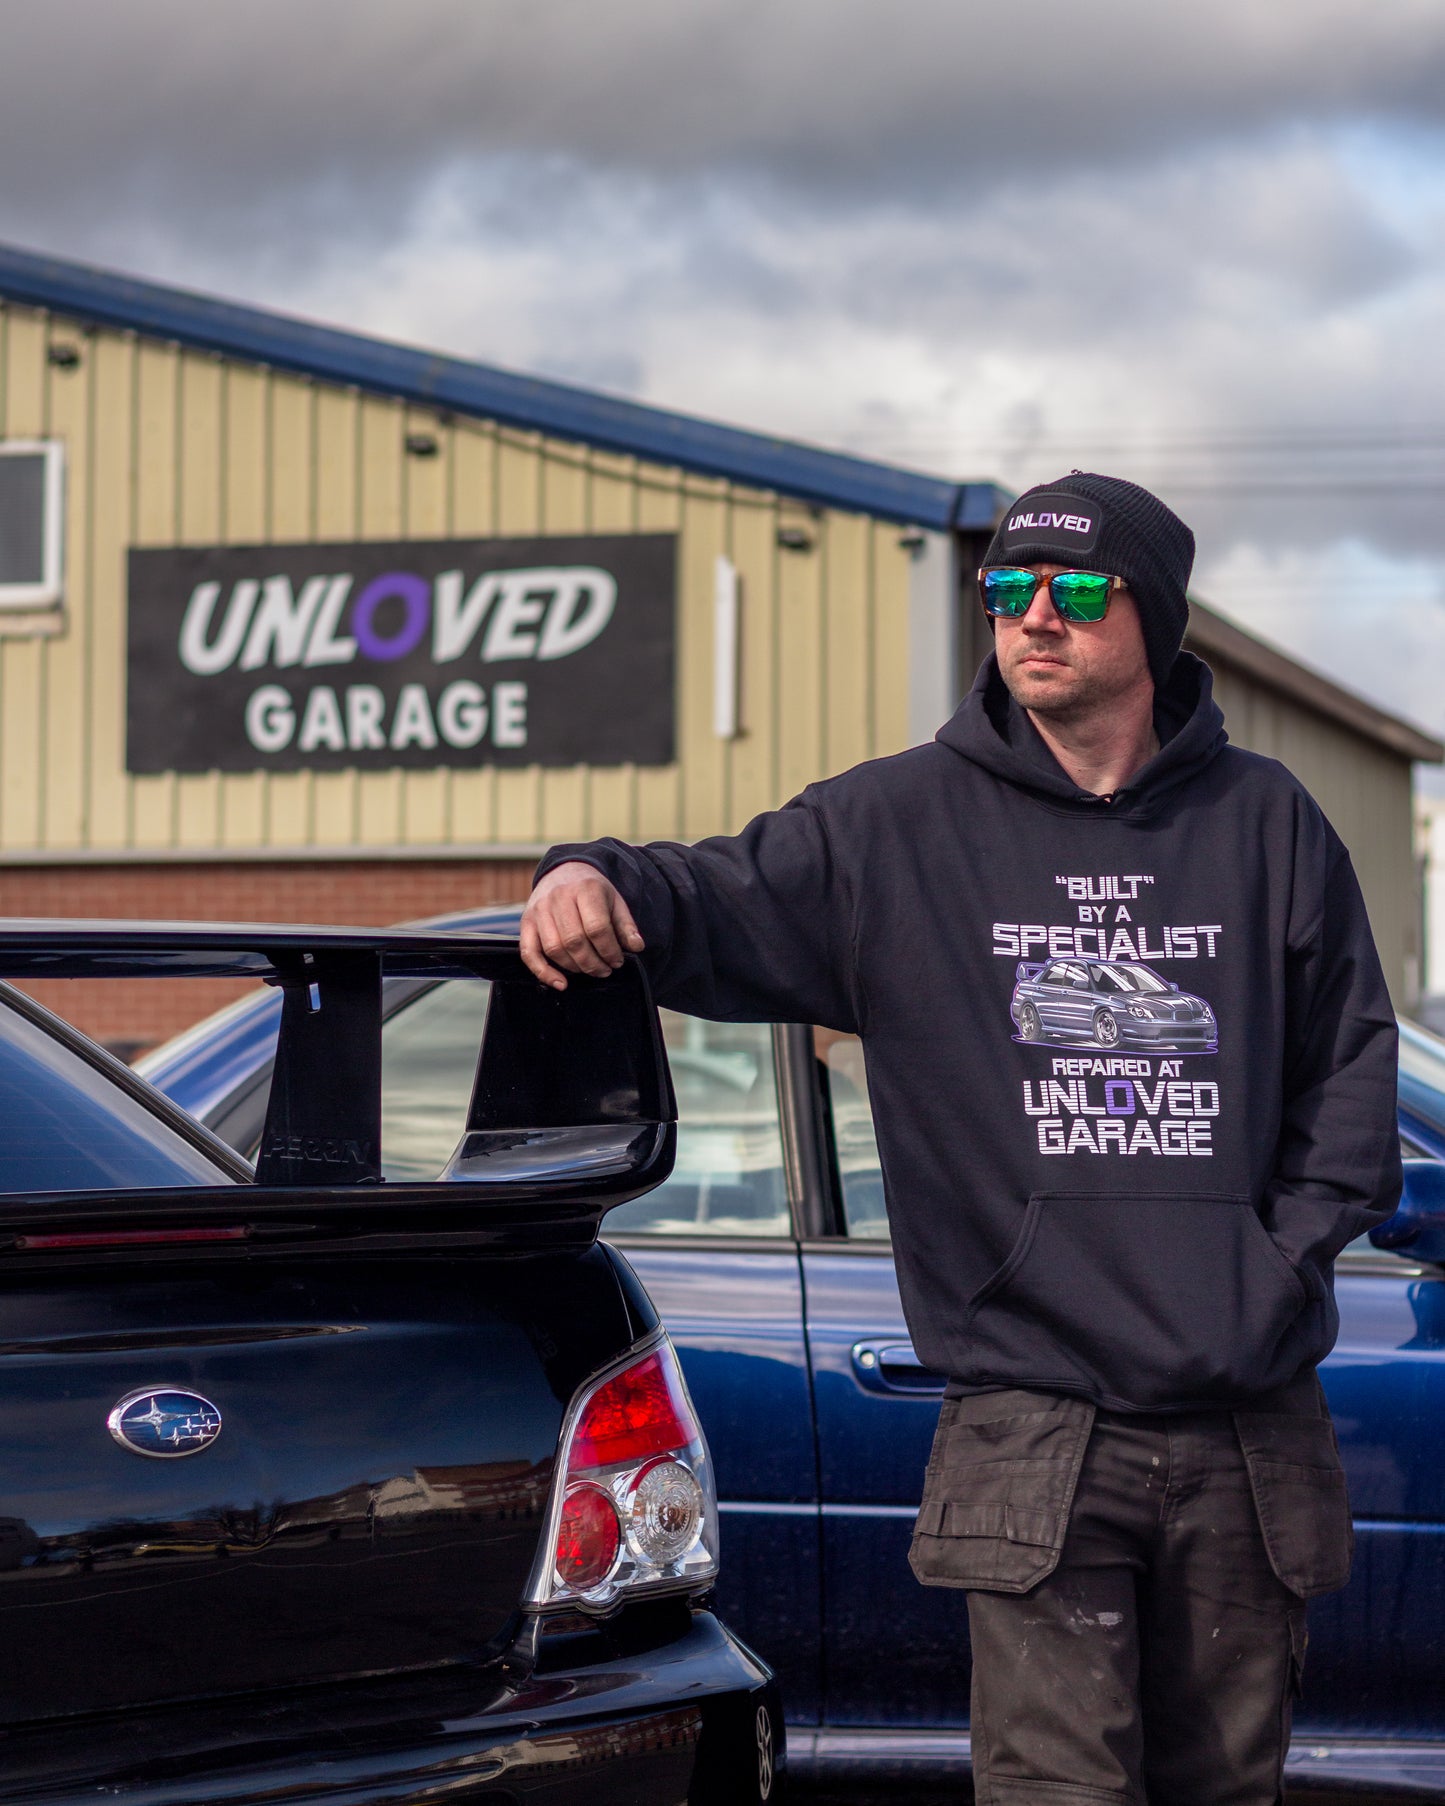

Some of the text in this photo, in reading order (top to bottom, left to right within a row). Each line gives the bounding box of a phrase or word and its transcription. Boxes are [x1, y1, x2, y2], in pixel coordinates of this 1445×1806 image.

[1008, 512, 1091, 533] UNLOVED
[179, 565, 617, 675] UNLOVED
[246, 680, 527, 752] GARAGE
[1078, 904, 1132, 923] BY A
[992, 922, 1222, 961] SPECIALIST
[1052, 1058, 1183, 1077] REPAIRED AT
[1023, 1079, 1220, 1116] UNLOVED
[1037, 1118, 1213, 1156] GARAGE
